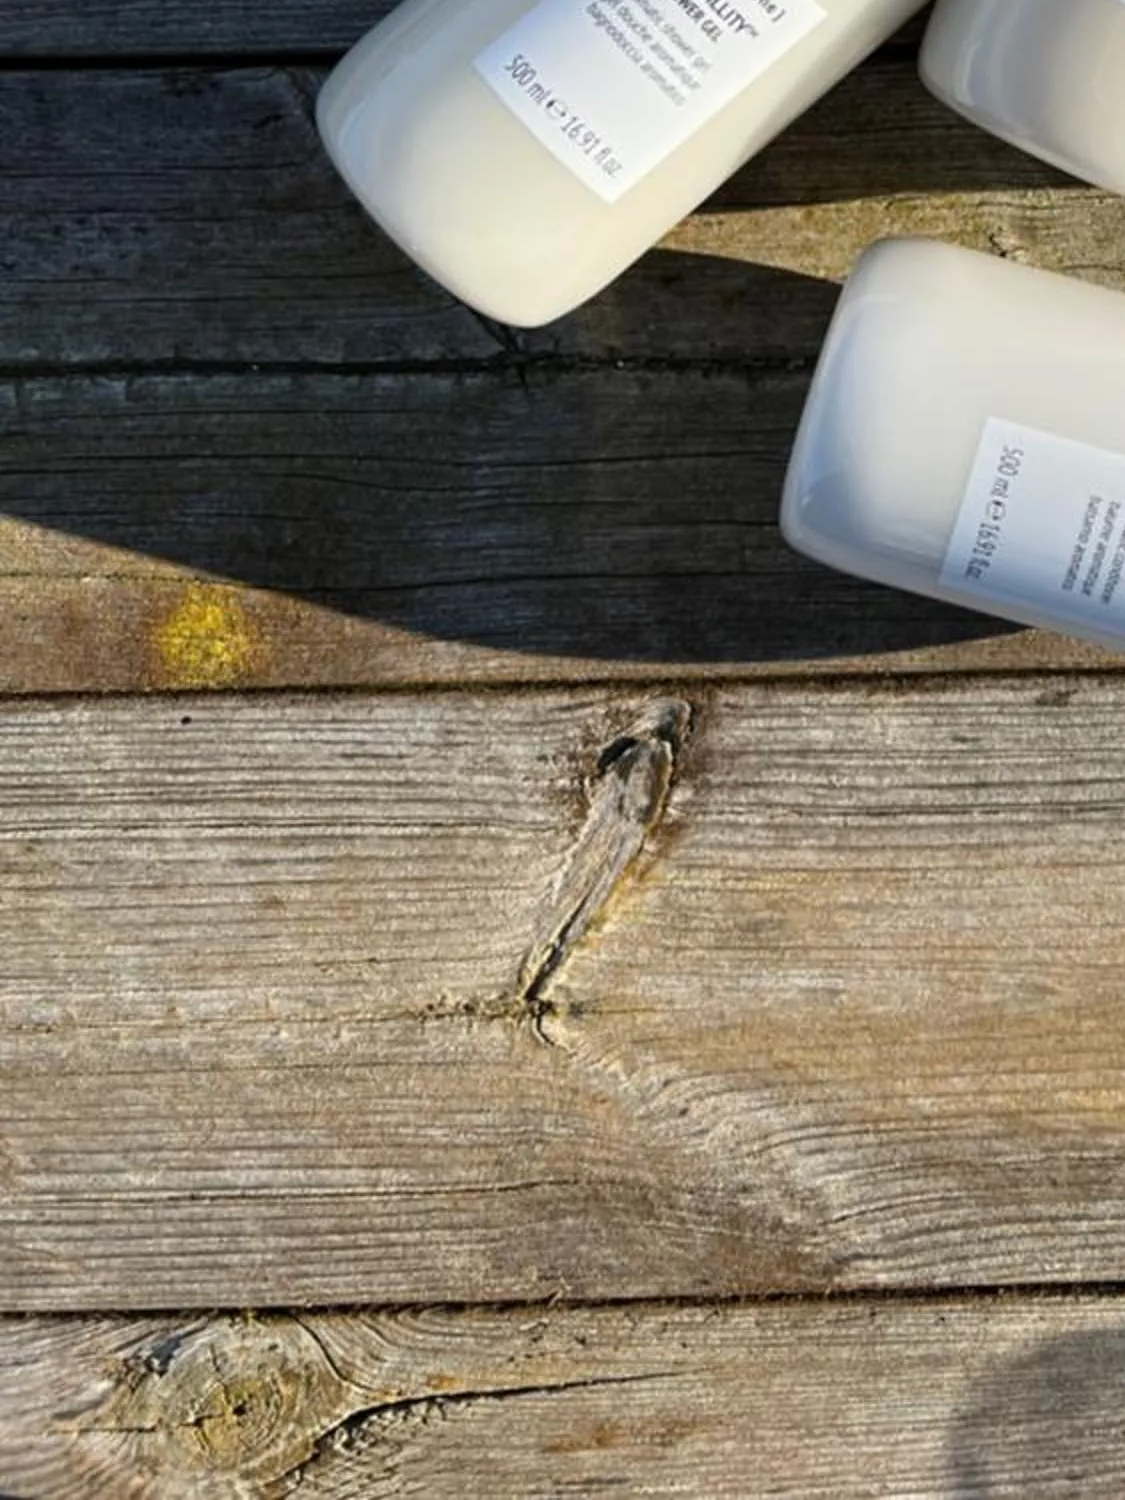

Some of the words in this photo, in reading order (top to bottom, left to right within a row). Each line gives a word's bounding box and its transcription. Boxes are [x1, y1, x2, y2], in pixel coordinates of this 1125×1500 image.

[698, 18, 724, 44] GEL
[503, 53, 539, 88] 500
[525, 79, 552, 105] ml
[995, 445, 1024, 478] 500
[989, 476, 1012, 500] ml
